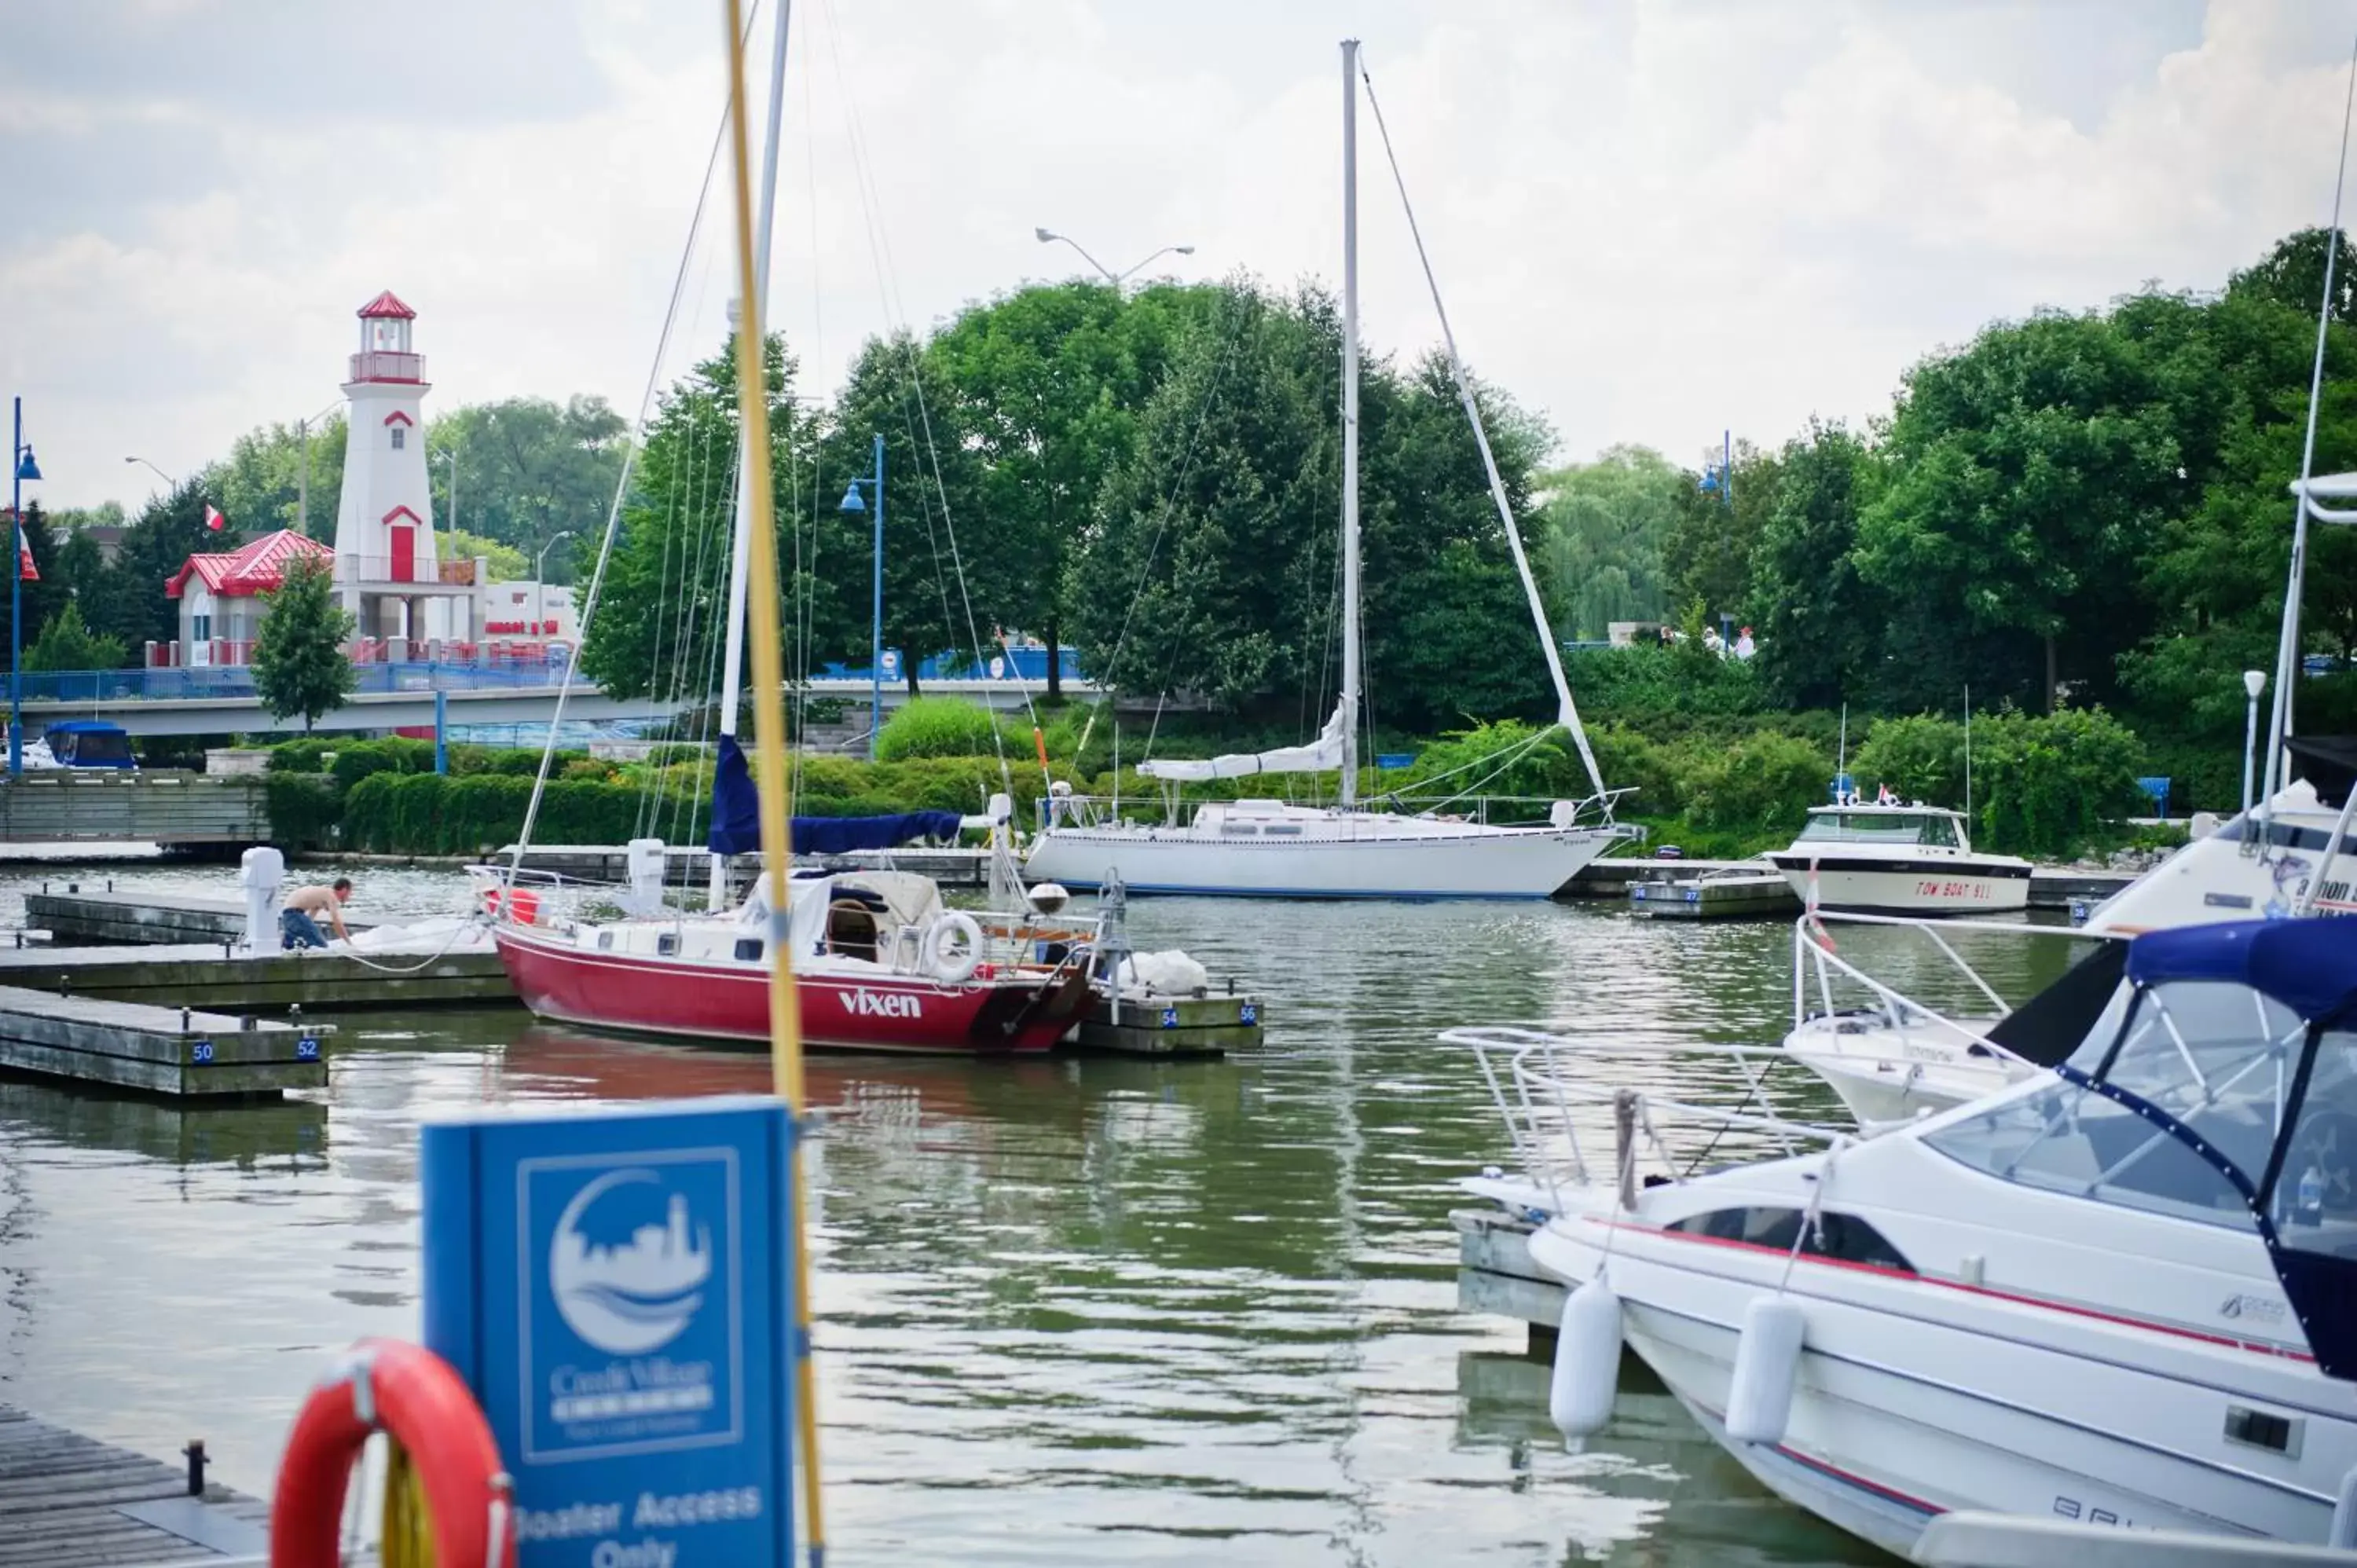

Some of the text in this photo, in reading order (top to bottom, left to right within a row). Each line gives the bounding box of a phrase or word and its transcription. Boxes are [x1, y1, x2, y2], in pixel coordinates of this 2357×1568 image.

[1915, 881, 1938, 896] TOW
[1943, 881, 1969, 898] BOAT
[1162, 1010, 1178, 1025] 54
[1241, 1006, 1255, 1020] 56
[193, 1044, 213, 1061] 50
[298, 1040, 316, 1056] 52
[635, 1488, 761, 1528] Access
